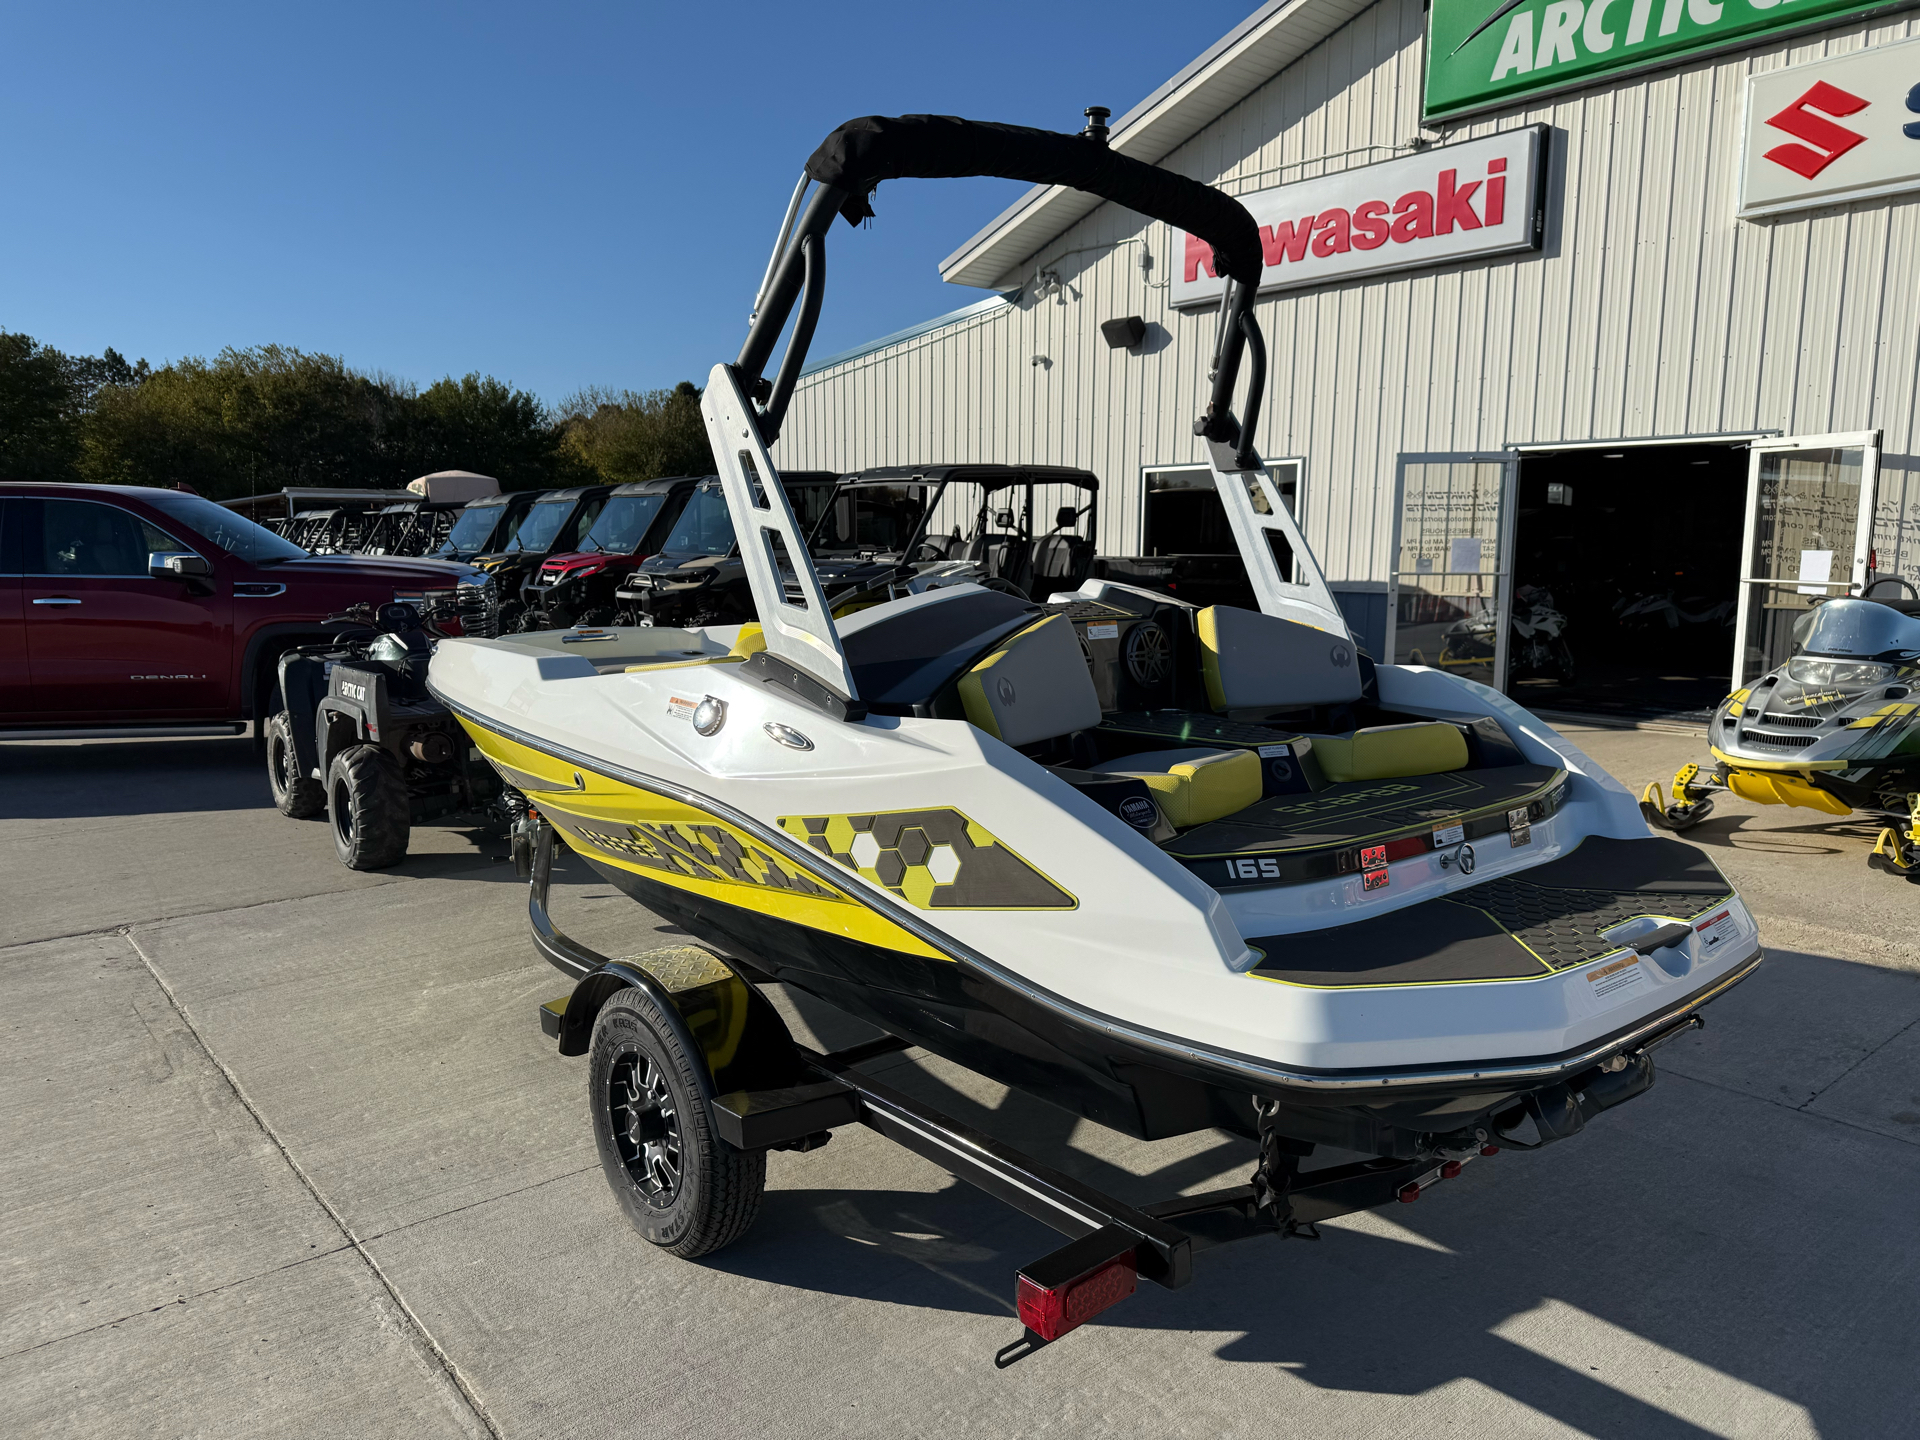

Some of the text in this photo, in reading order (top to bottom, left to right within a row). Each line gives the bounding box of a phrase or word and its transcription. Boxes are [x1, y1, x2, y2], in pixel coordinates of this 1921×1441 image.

[1184, 157, 1507, 284] Kwasaki
[1122, 800, 1150, 814] YAMAHA
[1225, 858, 1281, 879] 165
